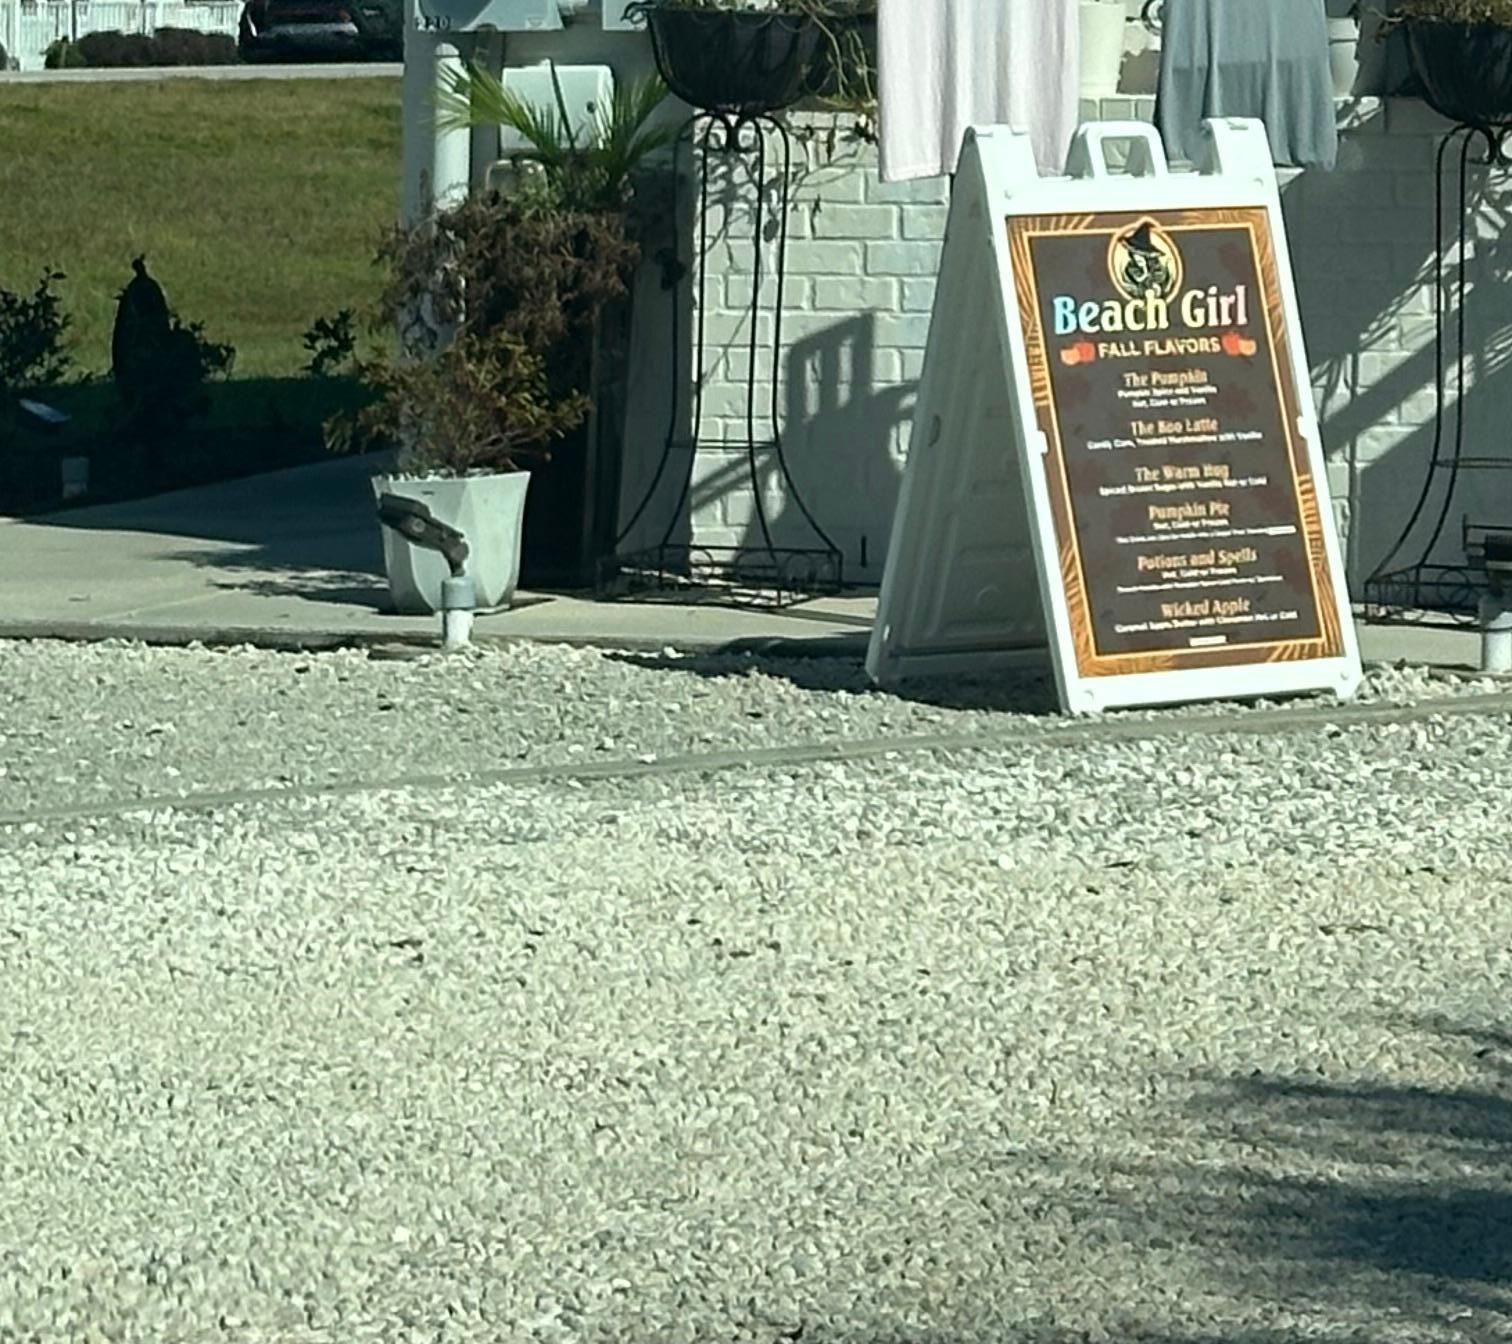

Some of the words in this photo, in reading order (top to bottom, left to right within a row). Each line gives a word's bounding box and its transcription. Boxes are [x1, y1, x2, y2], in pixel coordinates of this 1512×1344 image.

[1053, 287, 1170, 335] Beach
[1181, 284, 1248, 329] Girl
[1099, 342, 1141, 359] FALL
[1143, 337, 1222, 356] FLAVORS
[1123, 372, 1148, 387] The
[1151, 368, 1208, 387] Pumpkin
[1130, 421, 1154, 436] The
[1186, 417, 1219, 433] Latte
[1135, 467, 1161, 482] The
[1162, 465, 1201, 480] Warm
[1203, 463, 1230, 481] Hug
[1148, 502, 1207, 521] Pumpkin
[1209, 499, 1230, 516] Pie
[1137, 553, 1188, 571] Potions
[1190, 547, 1215, 566] and
[1218, 547, 1258, 566] Spells
[1161, 598, 1209, 618] Wicked
[1212, 596, 1251, 615] Apple
